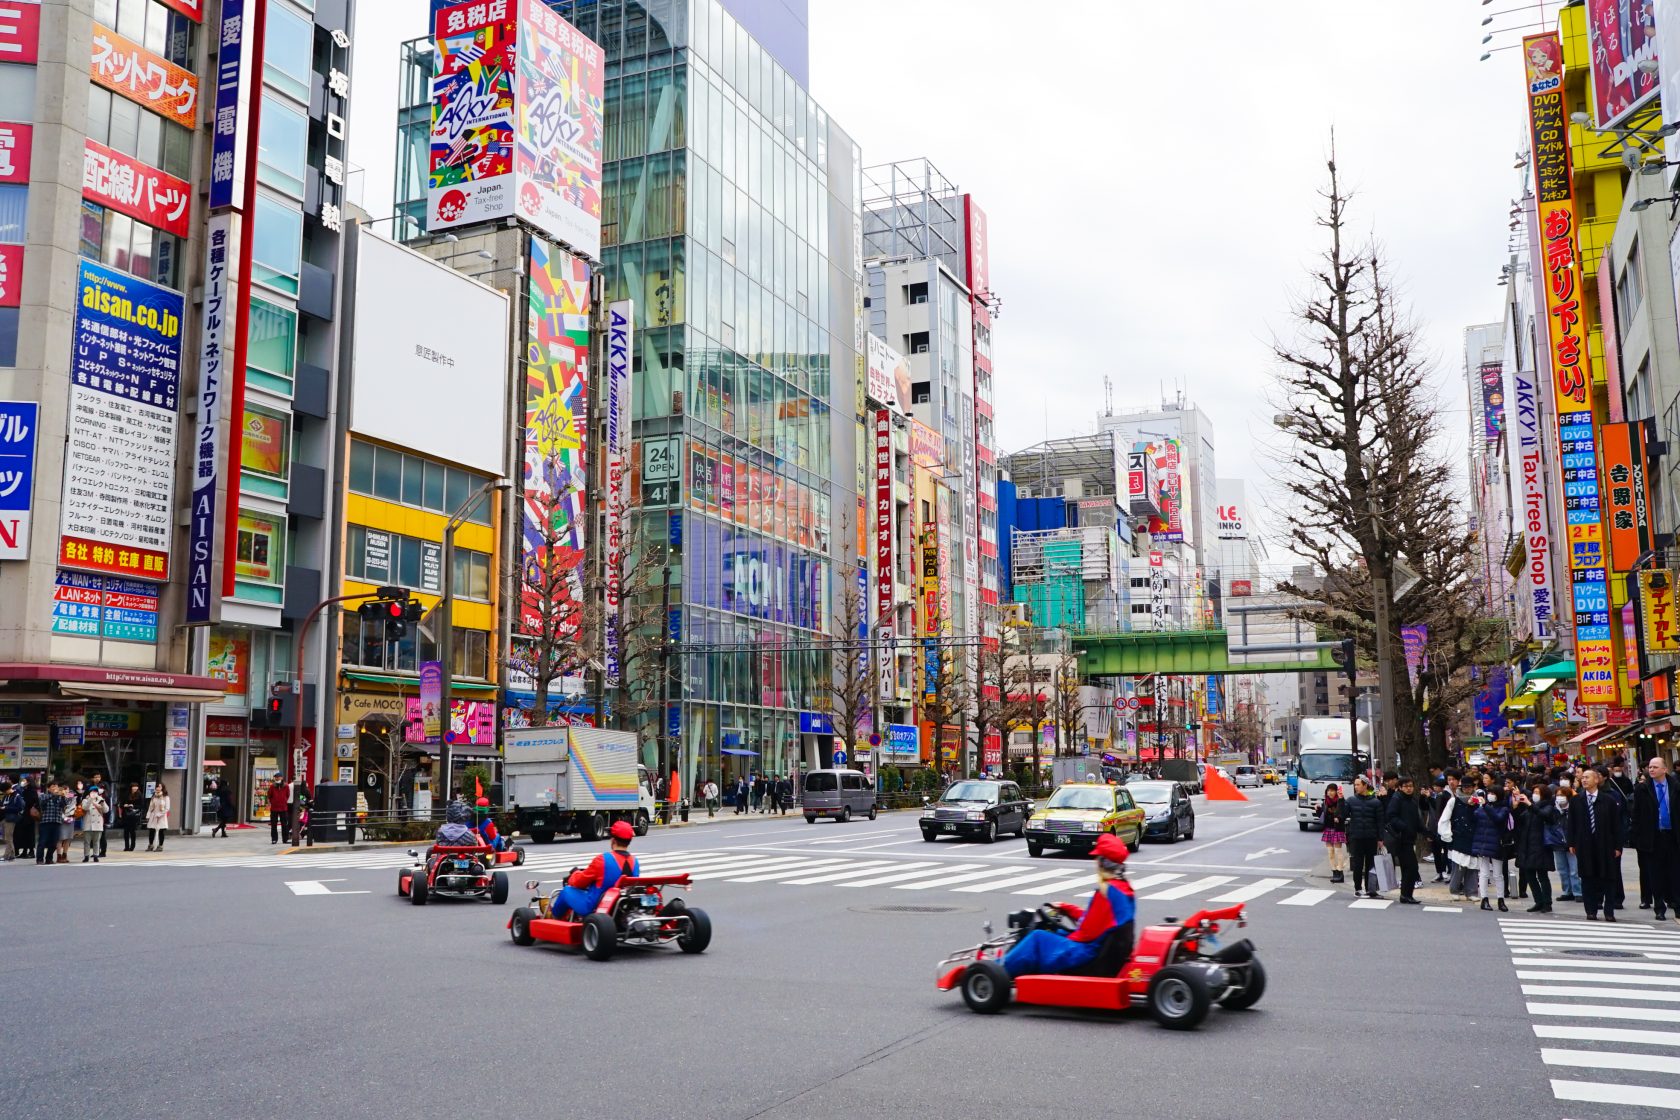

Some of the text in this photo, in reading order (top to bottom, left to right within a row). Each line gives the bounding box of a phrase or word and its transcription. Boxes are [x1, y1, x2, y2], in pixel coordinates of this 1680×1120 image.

[447, 0, 508, 33] 免税店
[91, 35, 197, 114] ネットワーク
[1531, 77, 1559, 93] あなたの
[213, 15, 242, 184] 愛三電機
[1534, 94, 1559, 107] DVD
[438, 90, 498, 131] AKKY
[466, 111, 509, 125] INTERNATIONAL
[1535, 118, 1562, 130] ゲーム
[1540, 130, 1558, 141] CD
[320, 67, 349, 234] 坂口電熱
[555, 136, 593, 165] INTERNATIONAL
[1537, 141, 1564, 154] アイドル
[1538, 153, 1565, 165] アニメ
[1540, 165, 1565, 177] コミック
[83, 148, 188, 222] 配線パーツ
[477, 183, 504, 195] Japan.
[1542, 179, 1566, 190] ホビー
[474, 193, 504, 206] Tax-free
[1542, 189, 1567, 201] フィギュア
[484, 203, 504, 213] Shop
[973, 210, 984, 292] カラオケ
[84, 270, 128, 294] http://www.
[82, 284, 179, 338] aisan.co.jp
[610, 310, 627, 379] AKKY
[198, 228, 227, 478] 各種ケーブル・ネットワーク機器
[415, 343, 455, 369] 意匠製作中
[1516, 376, 1537, 433] AKKY
[1559, 412, 1591, 425] 6F 中古
[1564, 430, 1591, 440] DVD
[1562, 440, 1593, 453] 5F 中古
[649, 463, 675, 474] OPEN
[1565, 457, 1594, 467] DVD
[1564, 468, 1596, 480] 4F 中古
[1168, 472, 1178, 500] DUTY
[1568, 485, 1596, 496] DVD
[1609, 463, 1635, 531] 吉野家
[1632, 463, 1647, 527] YOSHINOYA
[1566, 497, 1599, 508] 3F 中古
[1169, 500, 1181, 530] FREE
[1216, 505, 1242, 521] LE.
[1521, 450, 1548, 585] Tax-free Shop
[1568, 510, 1600, 523] PCゲーム
[669, 514, 682, 546] AOKI
[65, 541, 164, 573] 各社 特約 在庫 直販
[192, 494, 212, 609] AISAN
[1574, 555, 1602, 567] フロア
[1573, 568, 1605, 581] 1F 中古
[735, 554, 784, 611] AOKI
[1574, 584, 1606, 596] TVゲーム
[858, 578, 867, 624] AOKI
[1576, 598, 1606, 611] DVD
[926, 590, 937, 633] DVD
[1576, 612, 1608, 624] B1F 中古
[669, 609, 682, 642] AOKI
[1579, 626, 1608, 636] フィギュア
[880, 631, 892, 692] ダーツバー
[1581, 656, 1611, 667] ムーラン
[105, 672, 175, 685] http://www.aisan.co.jp
[1582, 671, 1612, 681] AKIBA
[1583, 686, 1613, 695] 中央通り店
[354, 699, 404, 710] Cafe MOCO
